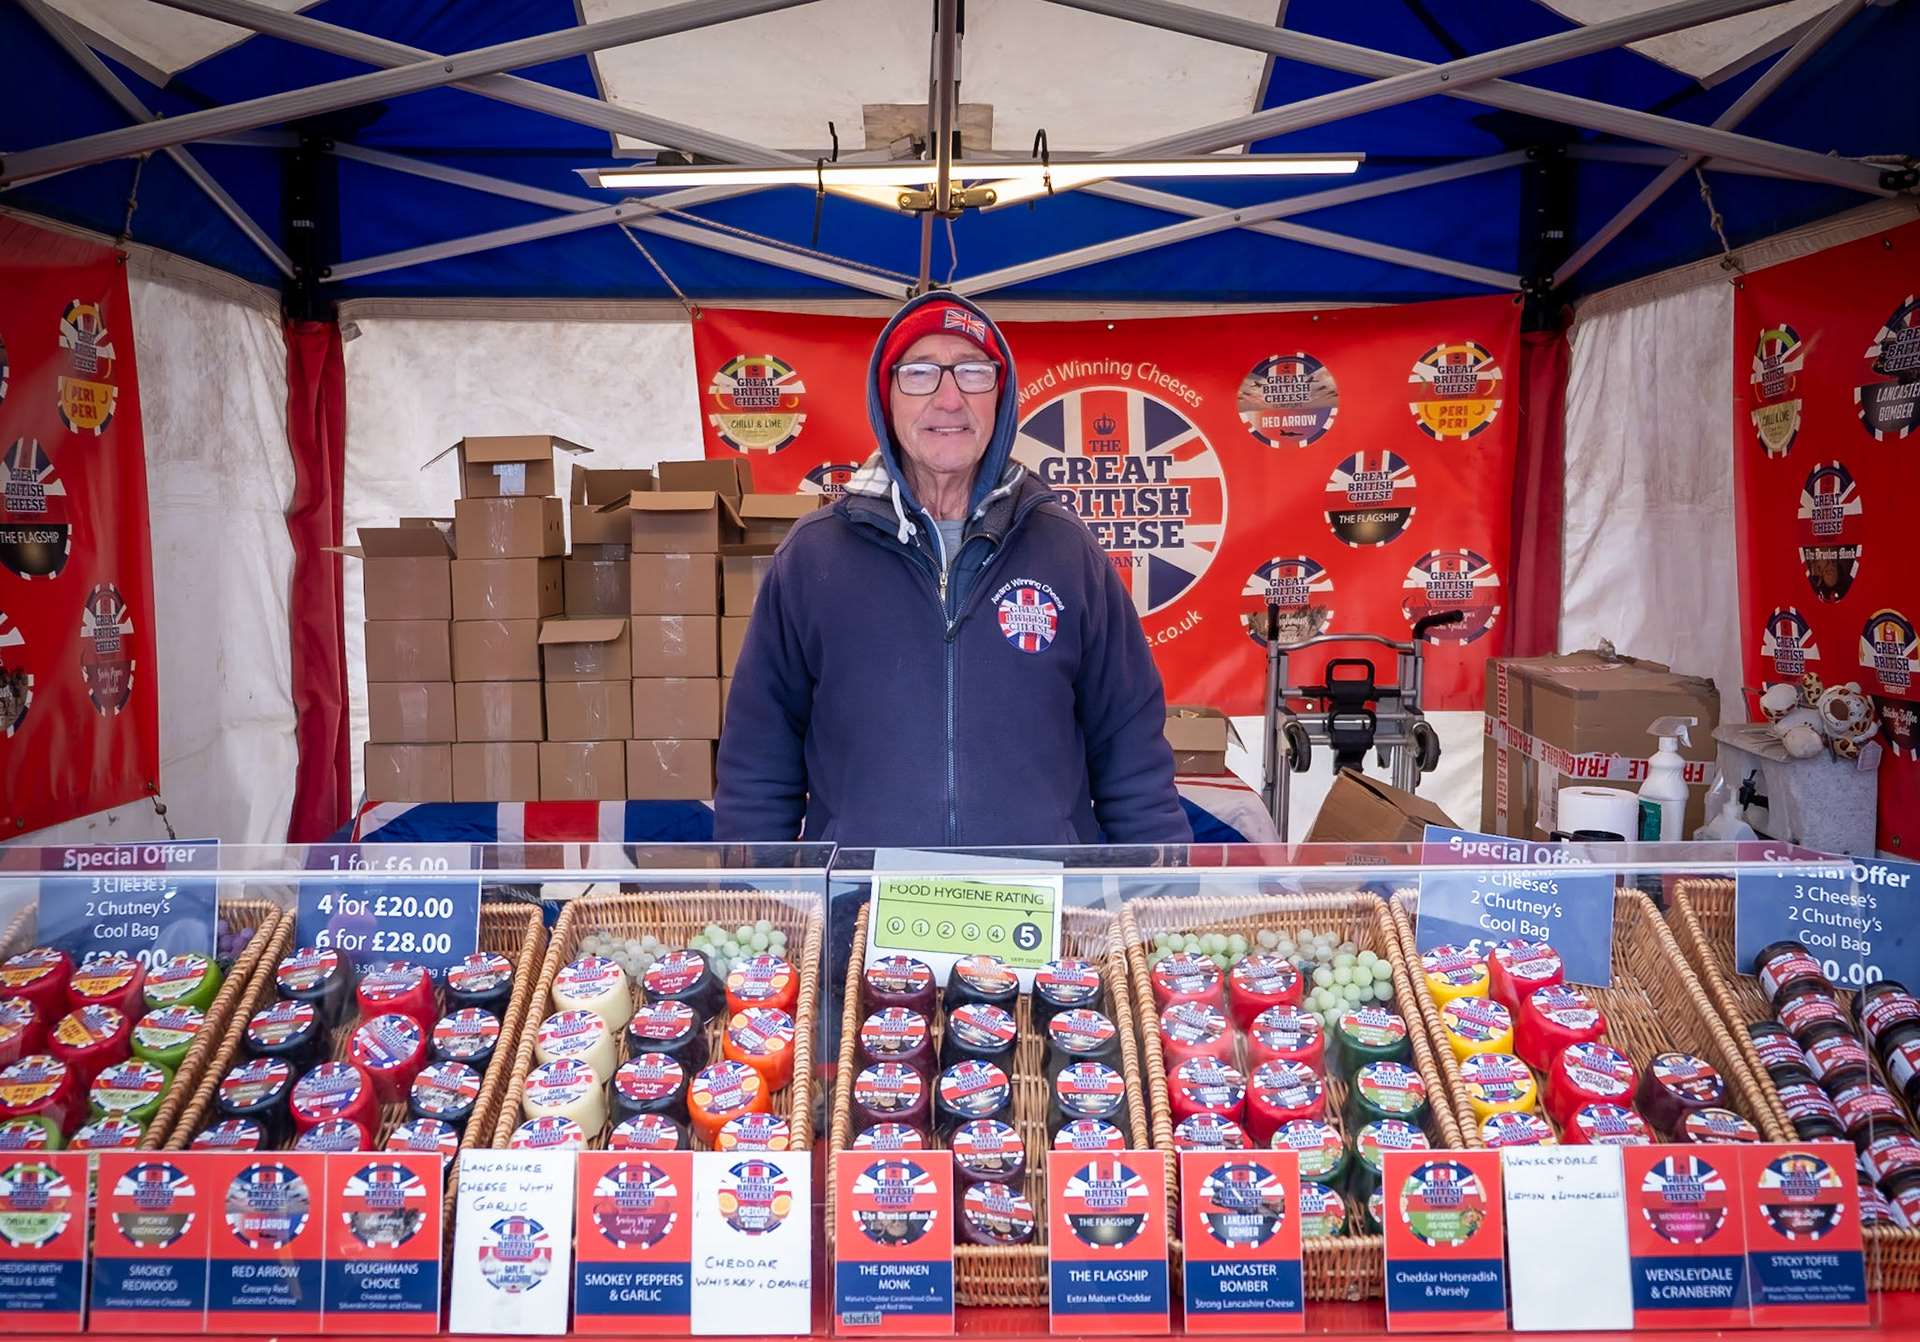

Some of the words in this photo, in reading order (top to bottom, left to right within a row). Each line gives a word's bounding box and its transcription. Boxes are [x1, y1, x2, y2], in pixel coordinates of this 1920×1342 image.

[1437, 364, 1475, 374] GREAT
[737, 378, 775, 387] GREAT
[1018, 368, 1056, 406] ward
[1056, 358, 1132, 383] Winning
[1137, 362, 1204, 409] Cheeses
[1267, 374, 1305, 384] GREAT
[1433, 374, 1477, 384] BRITISH
[71, 385, 96, 403] PERI
[733, 387, 780, 397] BRITISH
[1263, 383, 1311, 394] BRITISH
[1435, 383, 1476, 394] CHEESE
[734, 397, 779, 406] CHEESE
[1264, 393, 1310, 403] CHEESE
[71, 402, 97, 420] PERI
[1438, 405, 1468, 417] PERI
[1879, 402, 1915, 422] BOMBER
[731, 420, 754, 429] CHILLI
[757, 420, 762, 428] &
[765, 419, 782, 429] LIME
[1262, 415, 1280, 428] RED
[1282, 414, 1317, 427] ARROW
[1437, 417, 1467, 429] PERI
[1089, 440, 1121, 452] THE
[1039, 456, 1173, 485] GREAT
[1353, 471, 1390, 482] GREAT
[5, 483, 45, 497] BRITISH
[1348, 481, 1394, 492] BRITISH
[1349, 491, 1392, 501] CHEESE
[5, 498, 46, 511] CHEESE
[1055, 487, 1190, 518] RITISH
[1339, 514, 1355, 524] THE
[1357, 512, 1399, 524] FLAGSHIP
[18, 531, 59, 544] FLAGSHIP
[1087, 521, 1185, 549] EESE
[1269, 577, 1306, 587] GREAT
[1430, 572, 1470, 580] GREAT
[1264, 586, 1310, 596] BRITISH
[1426, 580, 1474, 590] BRITISH
[991, 582, 1012, 605] Award
[1010, 578, 1042, 590] Winning
[1427, 589, 1473, 599] CHEESE
[1266, 595, 1308, 605] CHEESE
[1874, 656, 1910, 671] BRITISH
[1876, 670, 1911, 687] CHEESE
[1497, 747, 1508, 819] FRAGILE
[1449, 835, 1529, 863] Special
[1534, 847, 1592, 864] Offer
[63, 847, 138, 870] Special
[143, 846, 197, 866] Offer
[330, 854, 339, 871] 1
[348, 853, 378, 871] for
[1851, 864, 1911, 889] Offer
[889, 884, 931, 897] FOOD
[934, 886, 992, 902] HYGIENE
[995, 891, 1045, 906] RATING
[1795, 885, 1804, 899] 3
[1808, 886, 1878, 909] Cheese's
[85, 902, 94, 917] 2
[98, 899, 171, 918] Chutney's
[317, 895, 333, 914] 4
[338, 893, 369, 915] for
[374, 896, 454, 919] £20.00
[1470, 890, 1480, 905] 2
[1484, 892, 1563, 919] Chutney's
[1788, 906, 1799, 921] 2
[1802, 908, 1883, 933] Chutney's
[94, 924, 127, 940] Cool
[131, 924, 159, 941] Bag
[1479, 914, 1516, 933] Cool
[1520, 922, 1550, 942] Bag
[315, 929, 331, 949] 6
[335, 928, 367, 951] for
[371, 931, 452, 955] £28.00
[1019, 925, 1036, 948] 5
[1799, 930, 1836, 948] Cool
[1841, 936, 1871, 955] Bag
[461, 1158, 542, 1173] LANCASHIRE
[520, 1182, 553, 1193] WITH
[473, 1196, 528, 1212] GARLIC
[244, 1218, 260, 1230] RED
[1079, 1218, 1094, 1227] THE
[1096, 1218, 1135, 1227] FLAGSHIP
[1223, 1214, 1264, 1225] LANCASTER
[1228, 1226, 1260, 1237] BOMBER
[705, 1256, 777, 1270] CHEDDAR
[1771, 1255, 1804, 1267] STICKY
[1805, 1255, 1839, 1267] TOFFEE
[129, 1265, 173, 1276] SMOKEY
[232, 1265, 255, 1278] RED
[257, 1265, 300, 1278] ARROW
[344, 1262, 419, 1275] PLOUGHMANS
[859, 1264, 879, 1276] THE
[880, 1264, 929, 1276] DRUNKEN
[1211, 1264, 1277, 1276] LANCASTER
[1645, 1267, 1733, 1282] WENSLEYDALE
[1790, 1269, 1822, 1280] TASTIC
[585, 1273, 633, 1286] SMOKEY
[635, 1273, 684, 1286] PEPPERS
[1069, 1270, 1091, 1282] THE
[1094, 1270, 1149, 1282] FLAGSHIP
[1396, 1271, 1438, 1283] Cheddar
[1439, 1270, 1498, 1282] Horseradish
[122, 1279, 178, 1291] REDWOOD
[361, 1277, 402, 1289] CHOICE
[878, 1279, 910, 1290] MONK
[1220, 1280, 1269, 1292] BOMBER
[242, 1284, 271, 1297] Creamy
[273, 1284, 289, 1295] Red
[609, 1289, 618, 1301] &
[620, 1289, 662, 1301] GARLIC
[1425, 1286, 1434, 1297] &
[1435, 1286, 1470, 1298] Parsely
[1650, 1286, 1661, 1299] &
[1662, 1285, 1733, 1299] CRANBERRY
[268, 1296, 297, 1306] Cheese
[1067, 1294, 1087, 1303] Extra
[1088, 1294, 1116, 1303] Mature
[1117, 1294, 1152, 1303] Cheddar
[1195, 1298, 1222, 1310] Strong
[1223, 1298, 1265, 1308] Lancashire
[1266, 1298, 1295, 1308] Cheese
[887, 1303, 898, 1311] Red
[842, 1312, 881, 1325] chefkit
